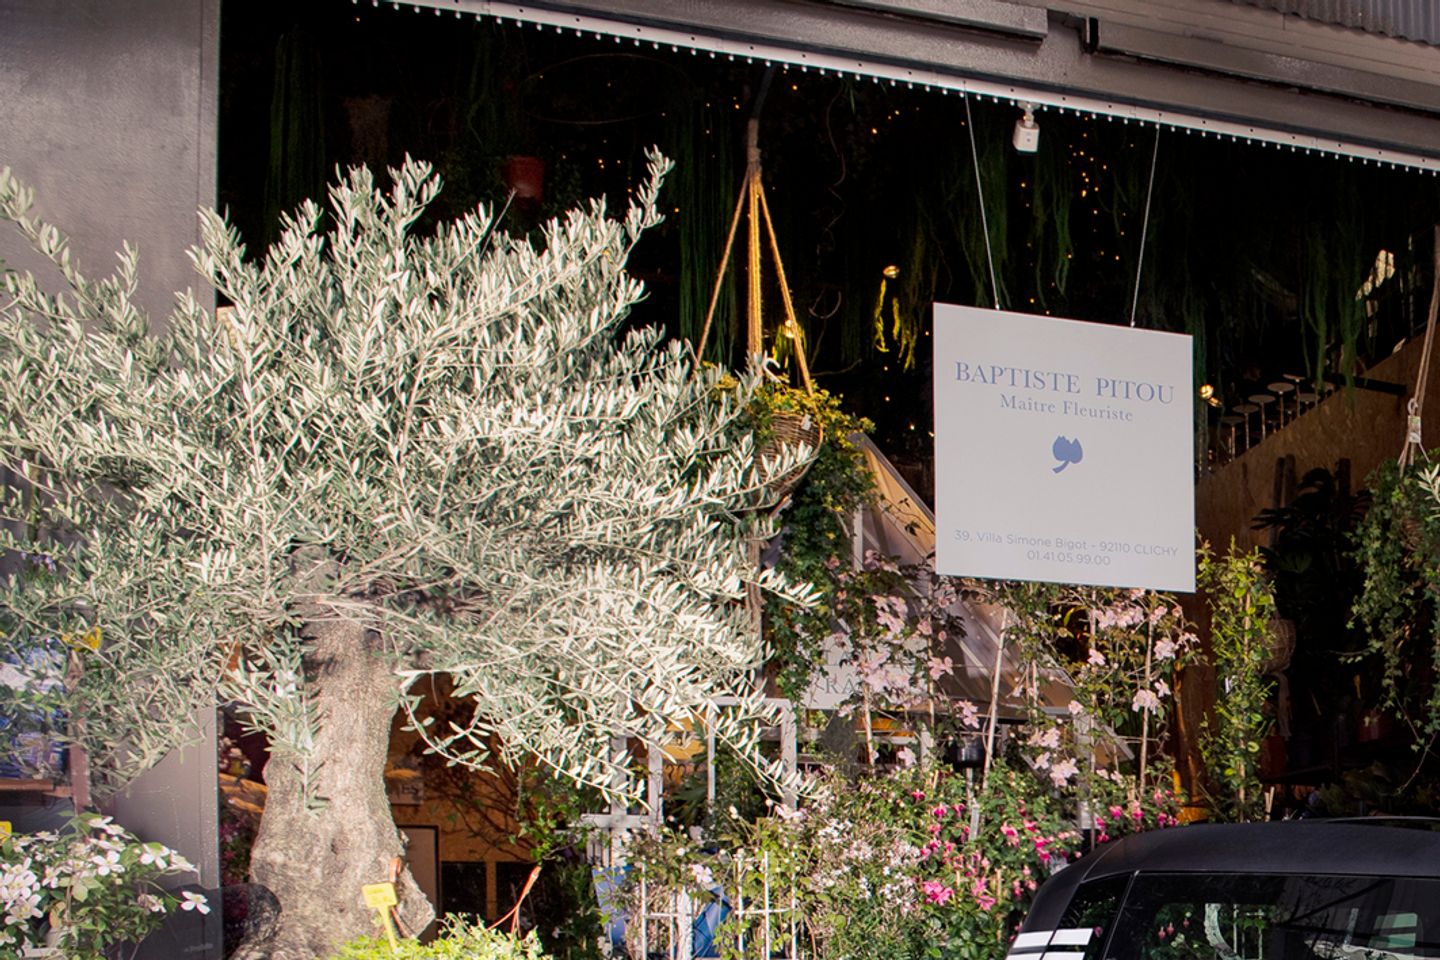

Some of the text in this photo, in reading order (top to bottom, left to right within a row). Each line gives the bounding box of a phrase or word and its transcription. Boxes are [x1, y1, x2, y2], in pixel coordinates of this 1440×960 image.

[955, 361, 1175, 405] BAPTISTE PITOU
[1000, 393, 1133, 422] Maître Fleuriste
[976, 531, 1002, 544] Villa
[1006, 534, 1052, 548] Simone
[1055, 537, 1088, 552] Bigot
[1099, 540, 1131, 554] 92110
[1134, 544, 1179, 557] CLICHY
